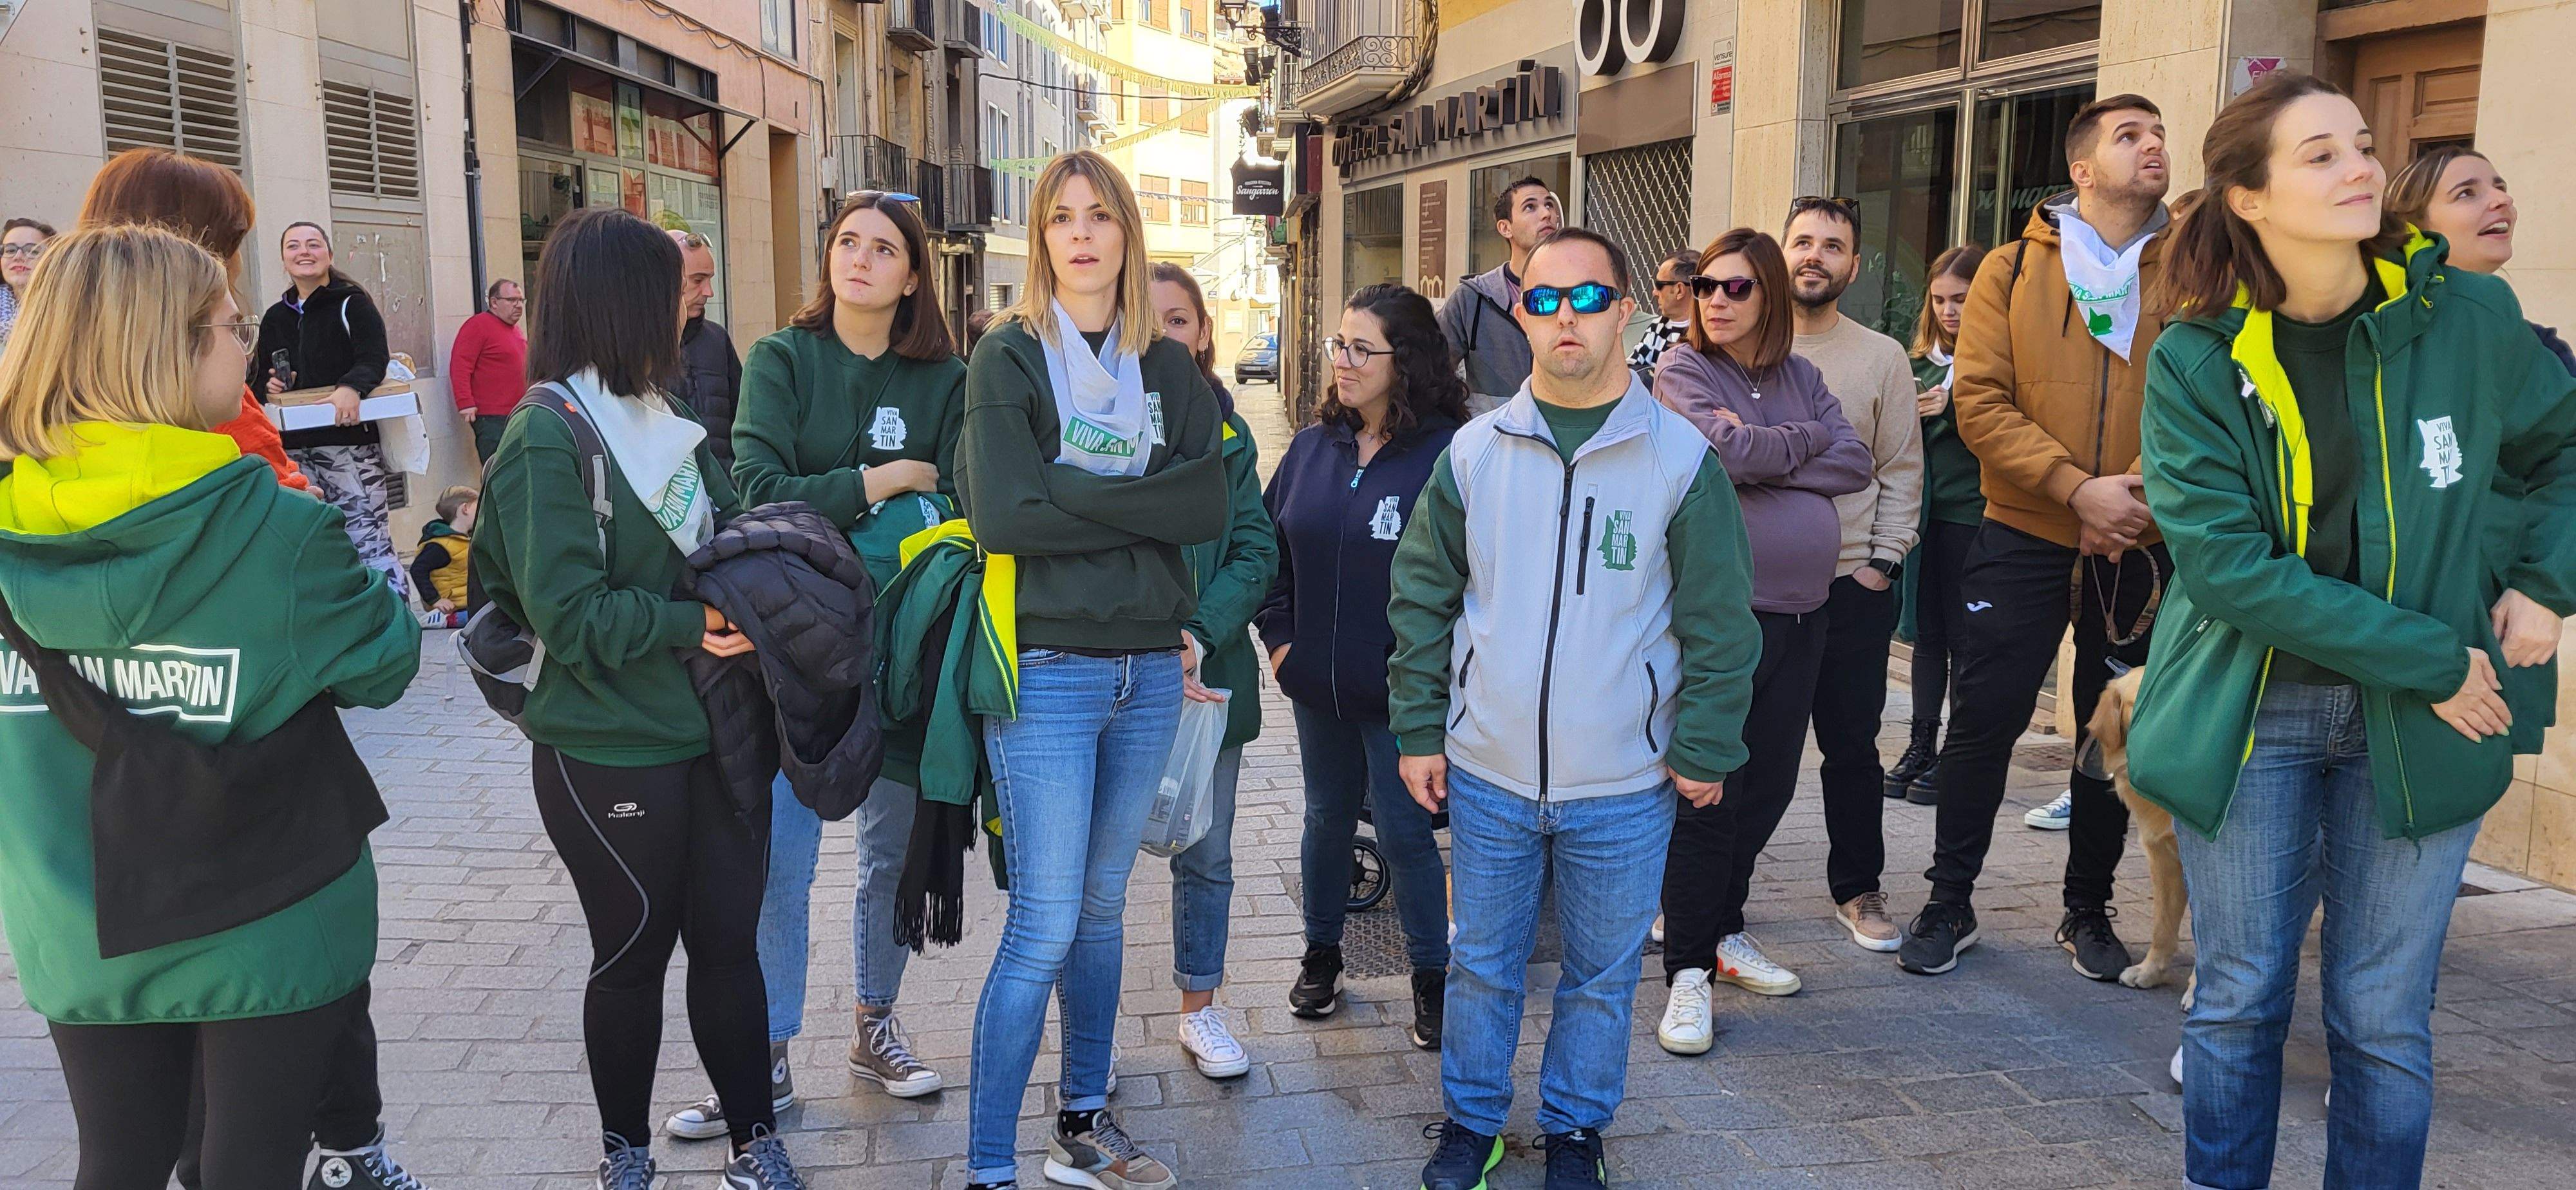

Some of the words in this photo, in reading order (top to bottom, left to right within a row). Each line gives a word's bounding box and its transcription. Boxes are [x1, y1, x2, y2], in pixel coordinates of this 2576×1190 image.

[1387, 105, 1434, 155] SAN
[1434, 59, 1561, 140] MARTÍN
[881, 416, 897, 426] SAN
[2436, 420, 2452, 432] VIVA
[880, 425, 896, 435] MAR
[1071, 420, 1105, 452] VIVA
[880, 435, 896, 447] TIN
[2434, 432, 2453, 450] SAN
[1383, 503, 1397, 513] SAN
[1381, 513, 1394, 522] MAR
[1620, 511, 1631, 520] VIVA
[1379, 521, 1392, 534] TIN
[1613, 520, 1630, 534] SAN
[1611, 533, 1629, 547] MAR
[1611, 546, 1627, 565] TIN
[113, 658, 224, 707] MARTIN
[608, 809, 645, 819] Kalenji
